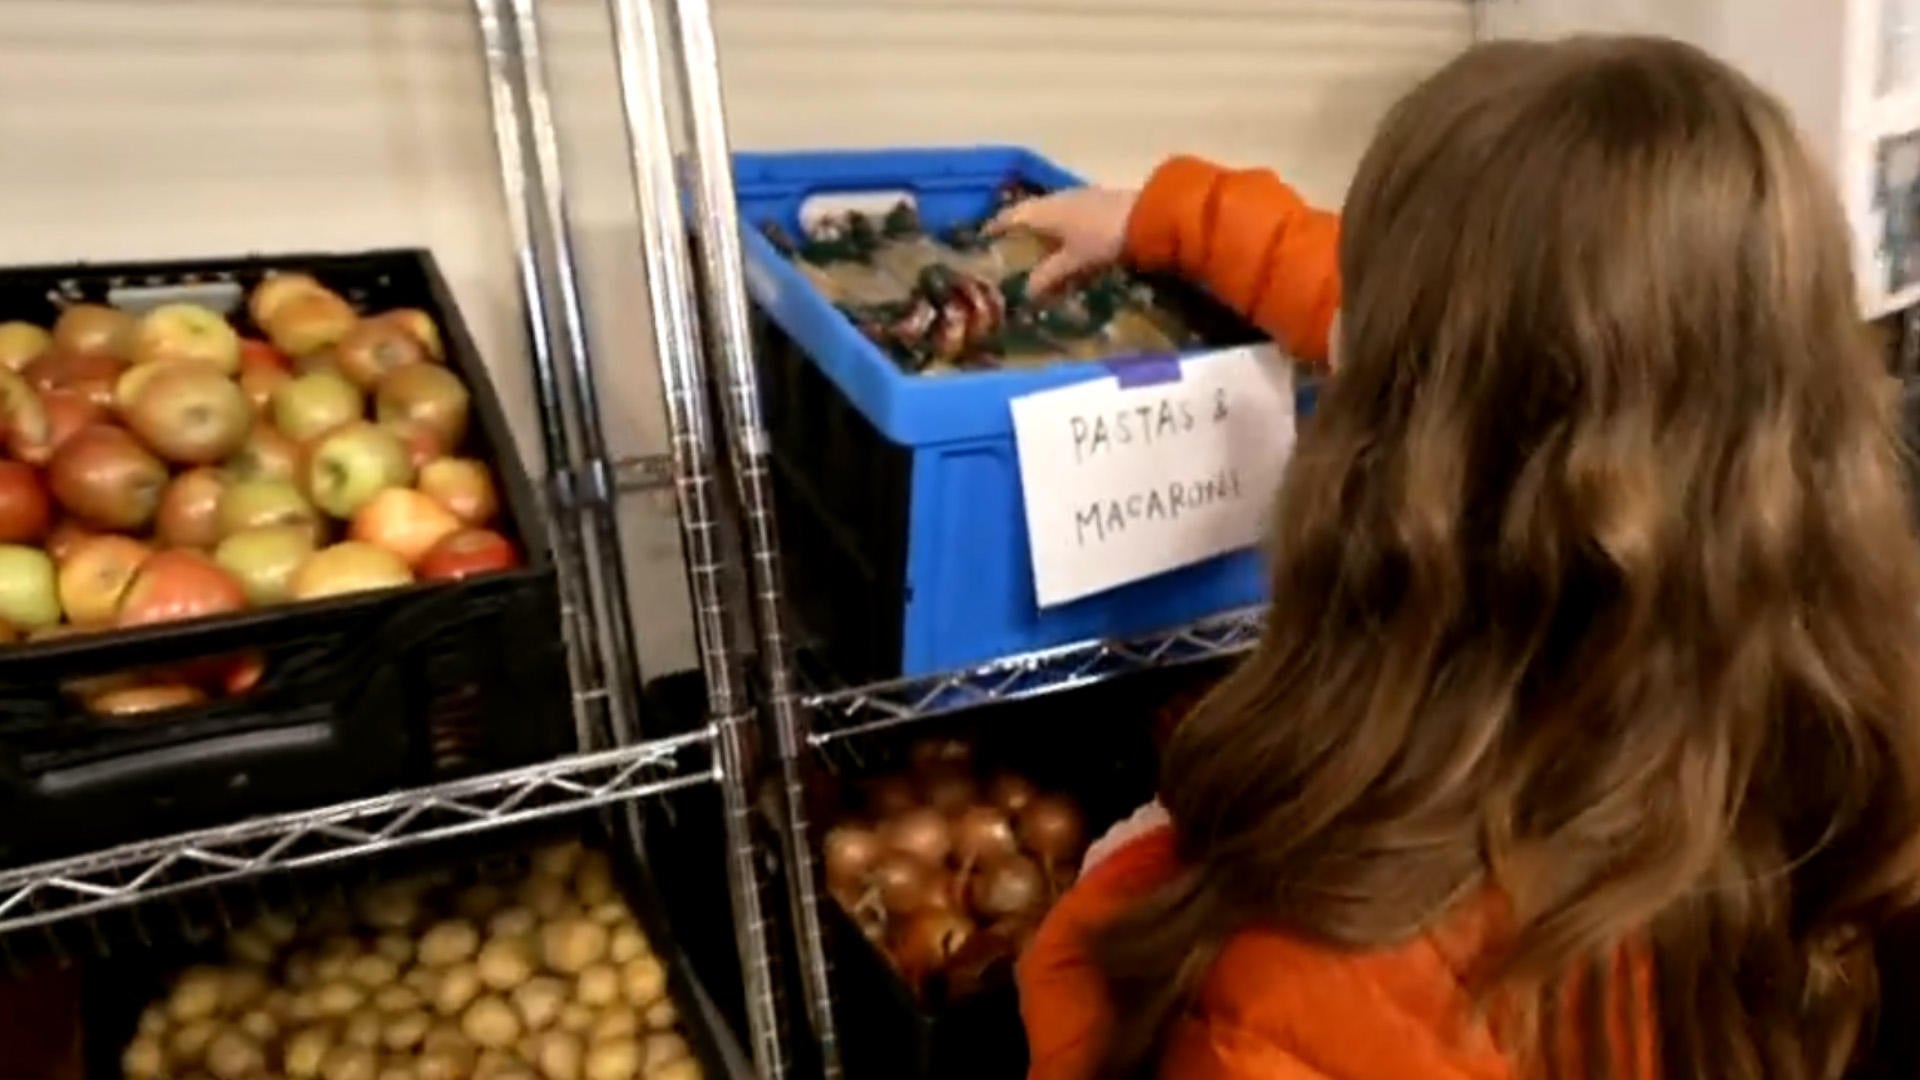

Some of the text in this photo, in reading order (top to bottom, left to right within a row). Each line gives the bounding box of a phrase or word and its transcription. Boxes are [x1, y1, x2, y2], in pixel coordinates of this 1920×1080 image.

[1069, 387, 1229, 462] PASTAS &
[1074, 470, 1241, 546] MACARONI
